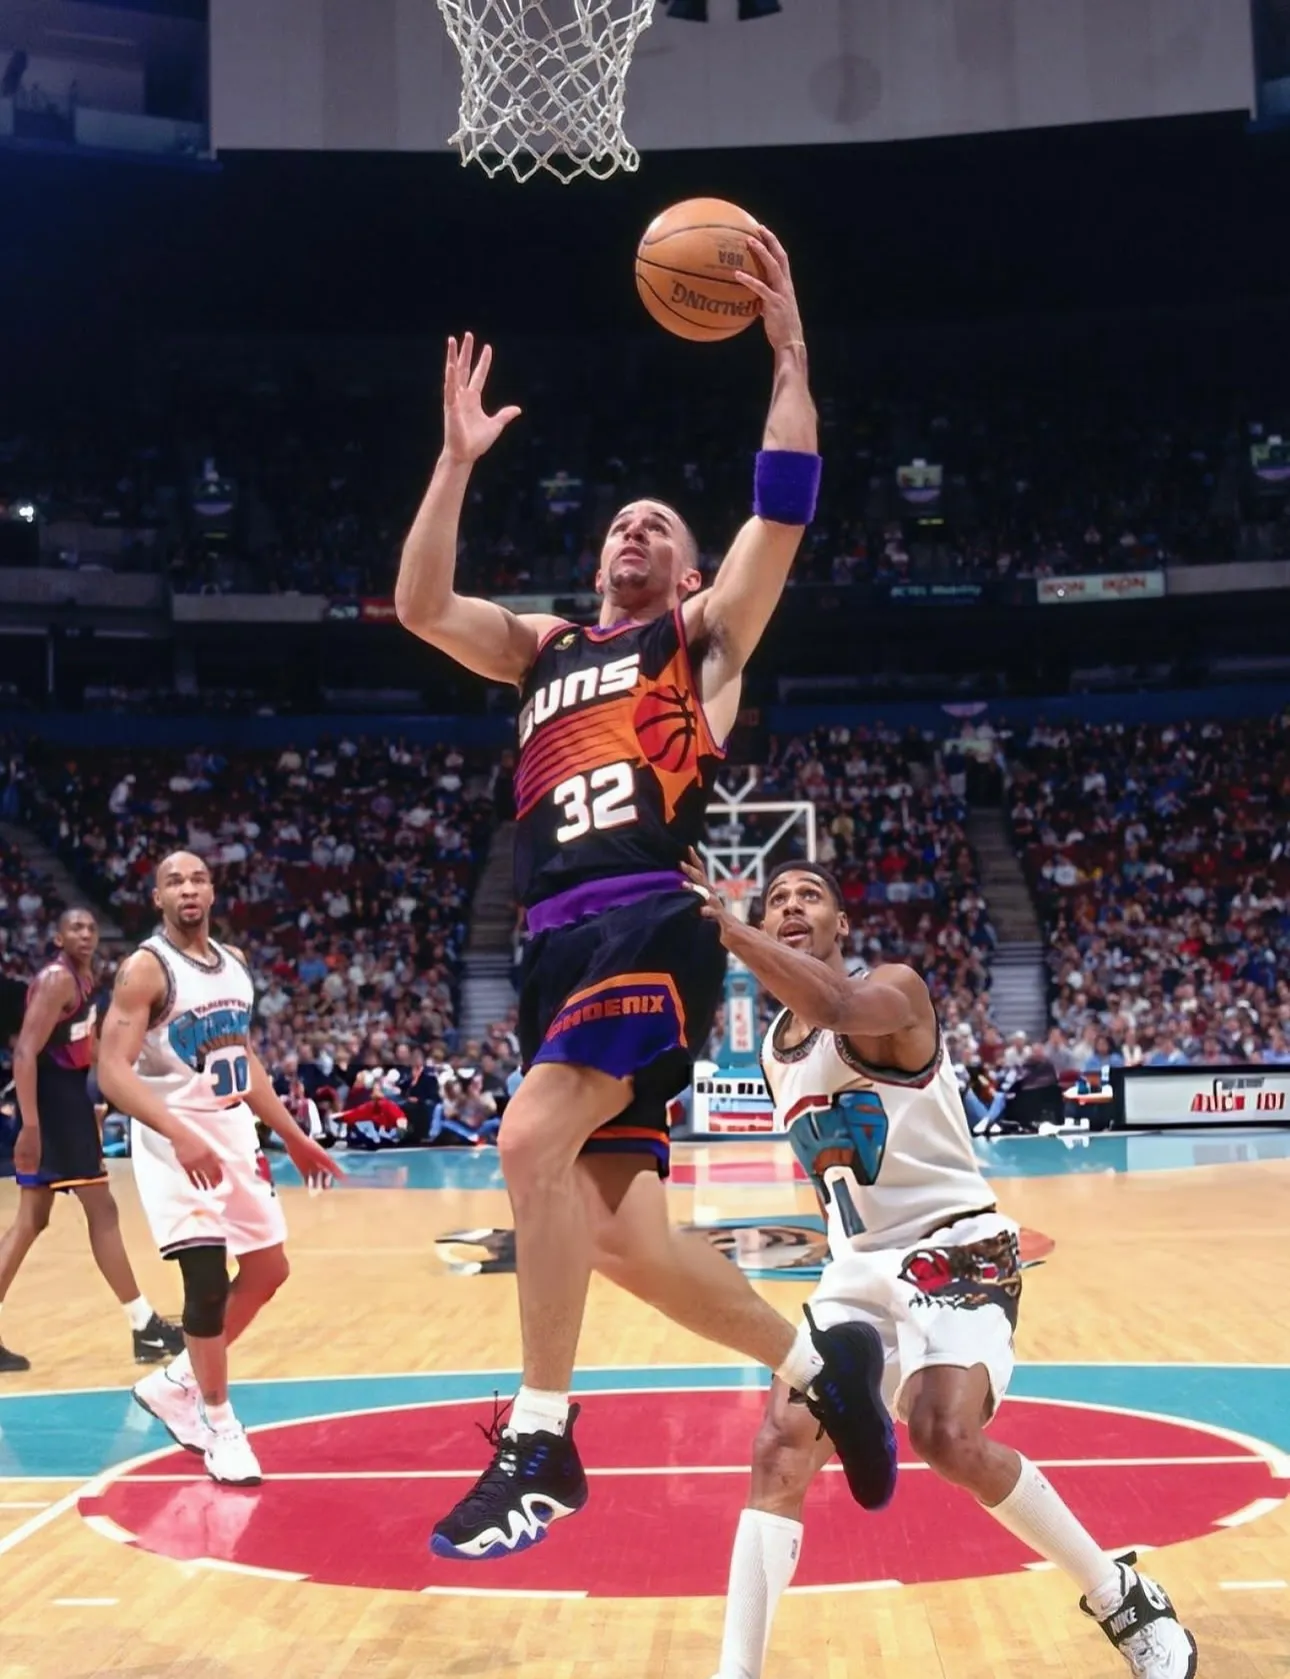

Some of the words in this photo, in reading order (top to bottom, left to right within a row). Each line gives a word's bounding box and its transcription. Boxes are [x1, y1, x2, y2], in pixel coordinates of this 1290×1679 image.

[718, 250, 744, 268] NBA
[671, 283, 762, 318] PALDING
[554, 762, 638, 843] 32
[1110, 1606, 1138, 1637] NIKE
